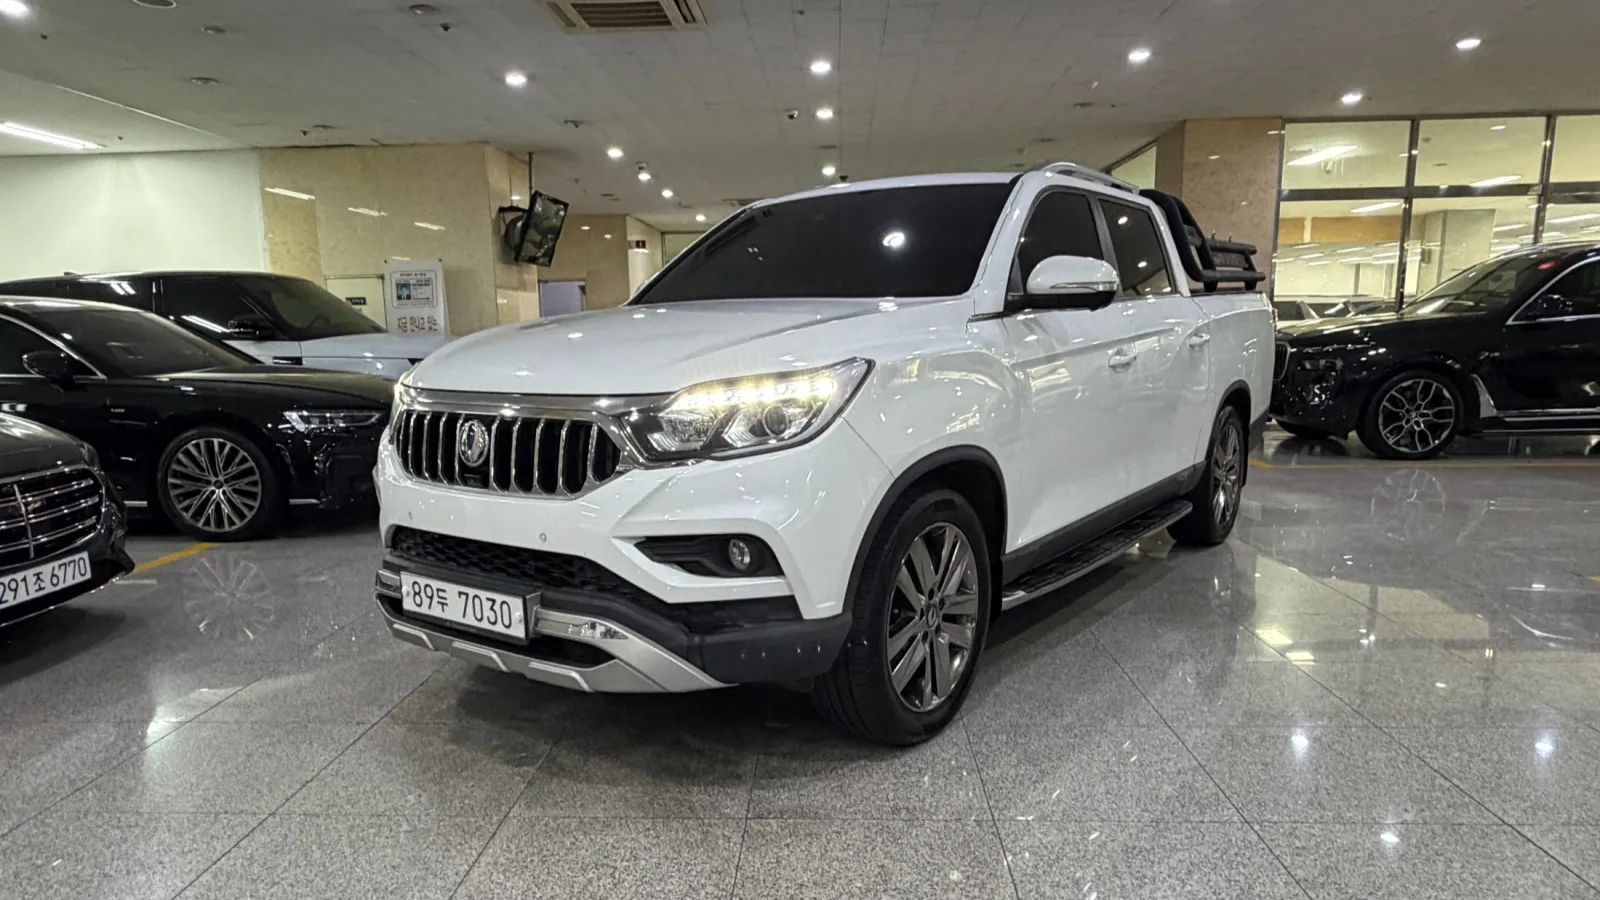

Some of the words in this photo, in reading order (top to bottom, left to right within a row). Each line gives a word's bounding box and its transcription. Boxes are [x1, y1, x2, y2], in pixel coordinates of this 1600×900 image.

[50, 557, 87, 587] 6770
[412, 581, 448, 611] 89두
[458, 591, 512, 629] 7030
